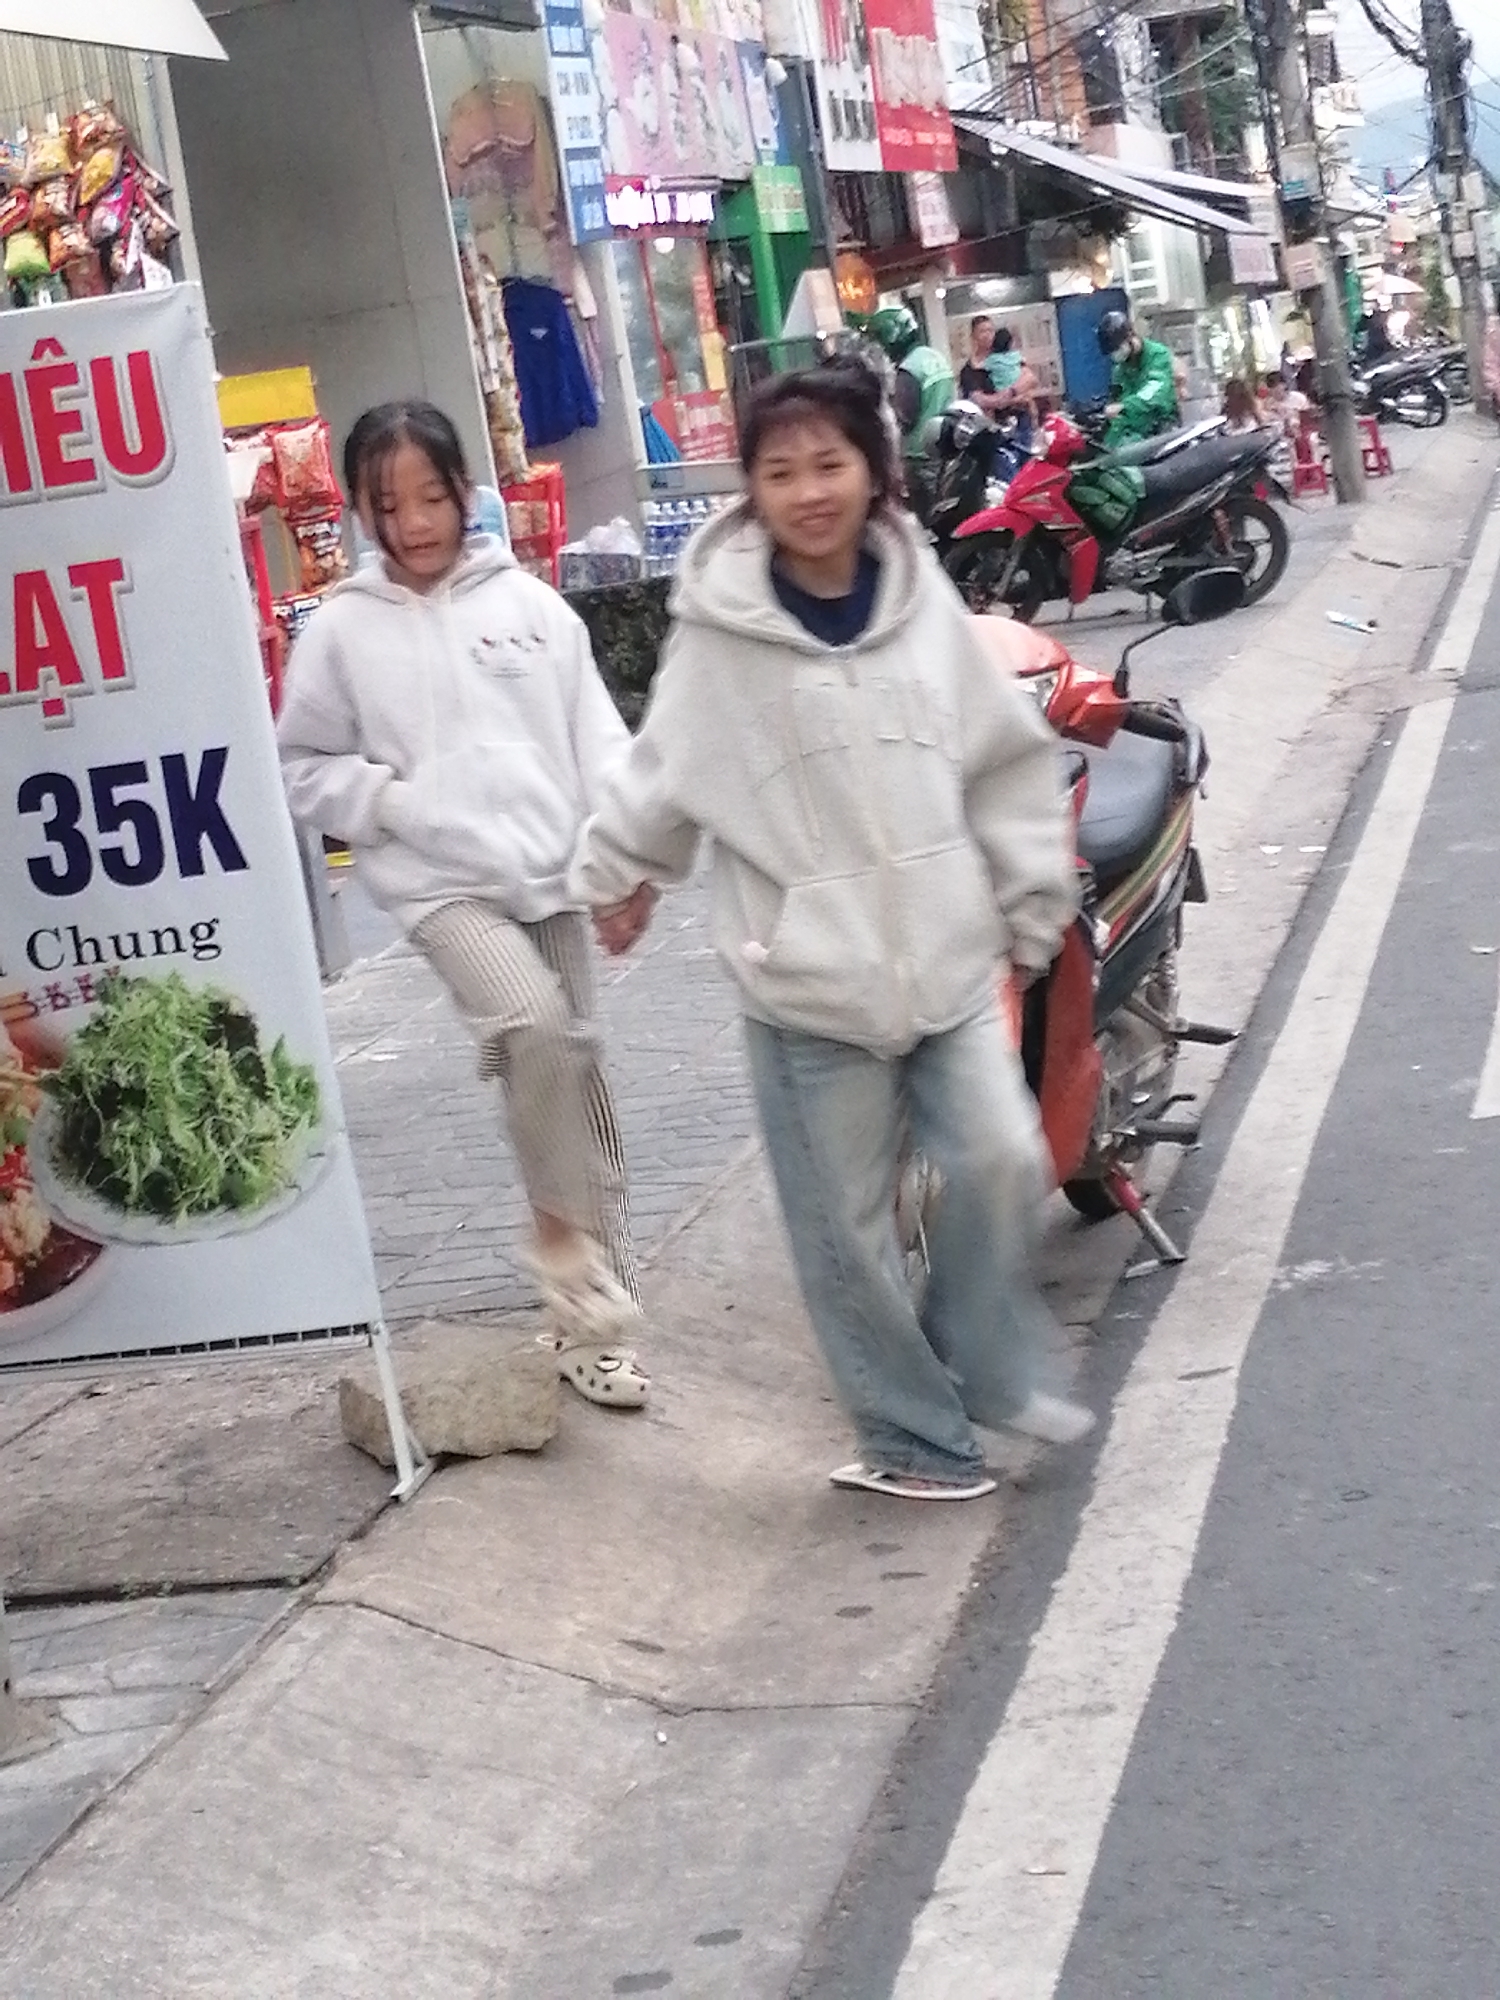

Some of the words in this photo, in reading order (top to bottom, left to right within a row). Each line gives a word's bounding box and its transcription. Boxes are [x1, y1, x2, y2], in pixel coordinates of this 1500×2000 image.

[0, 557, 127, 718] ẠT
[17, 746, 250, 896] 35K
[26, 917, 222, 972] Chung
